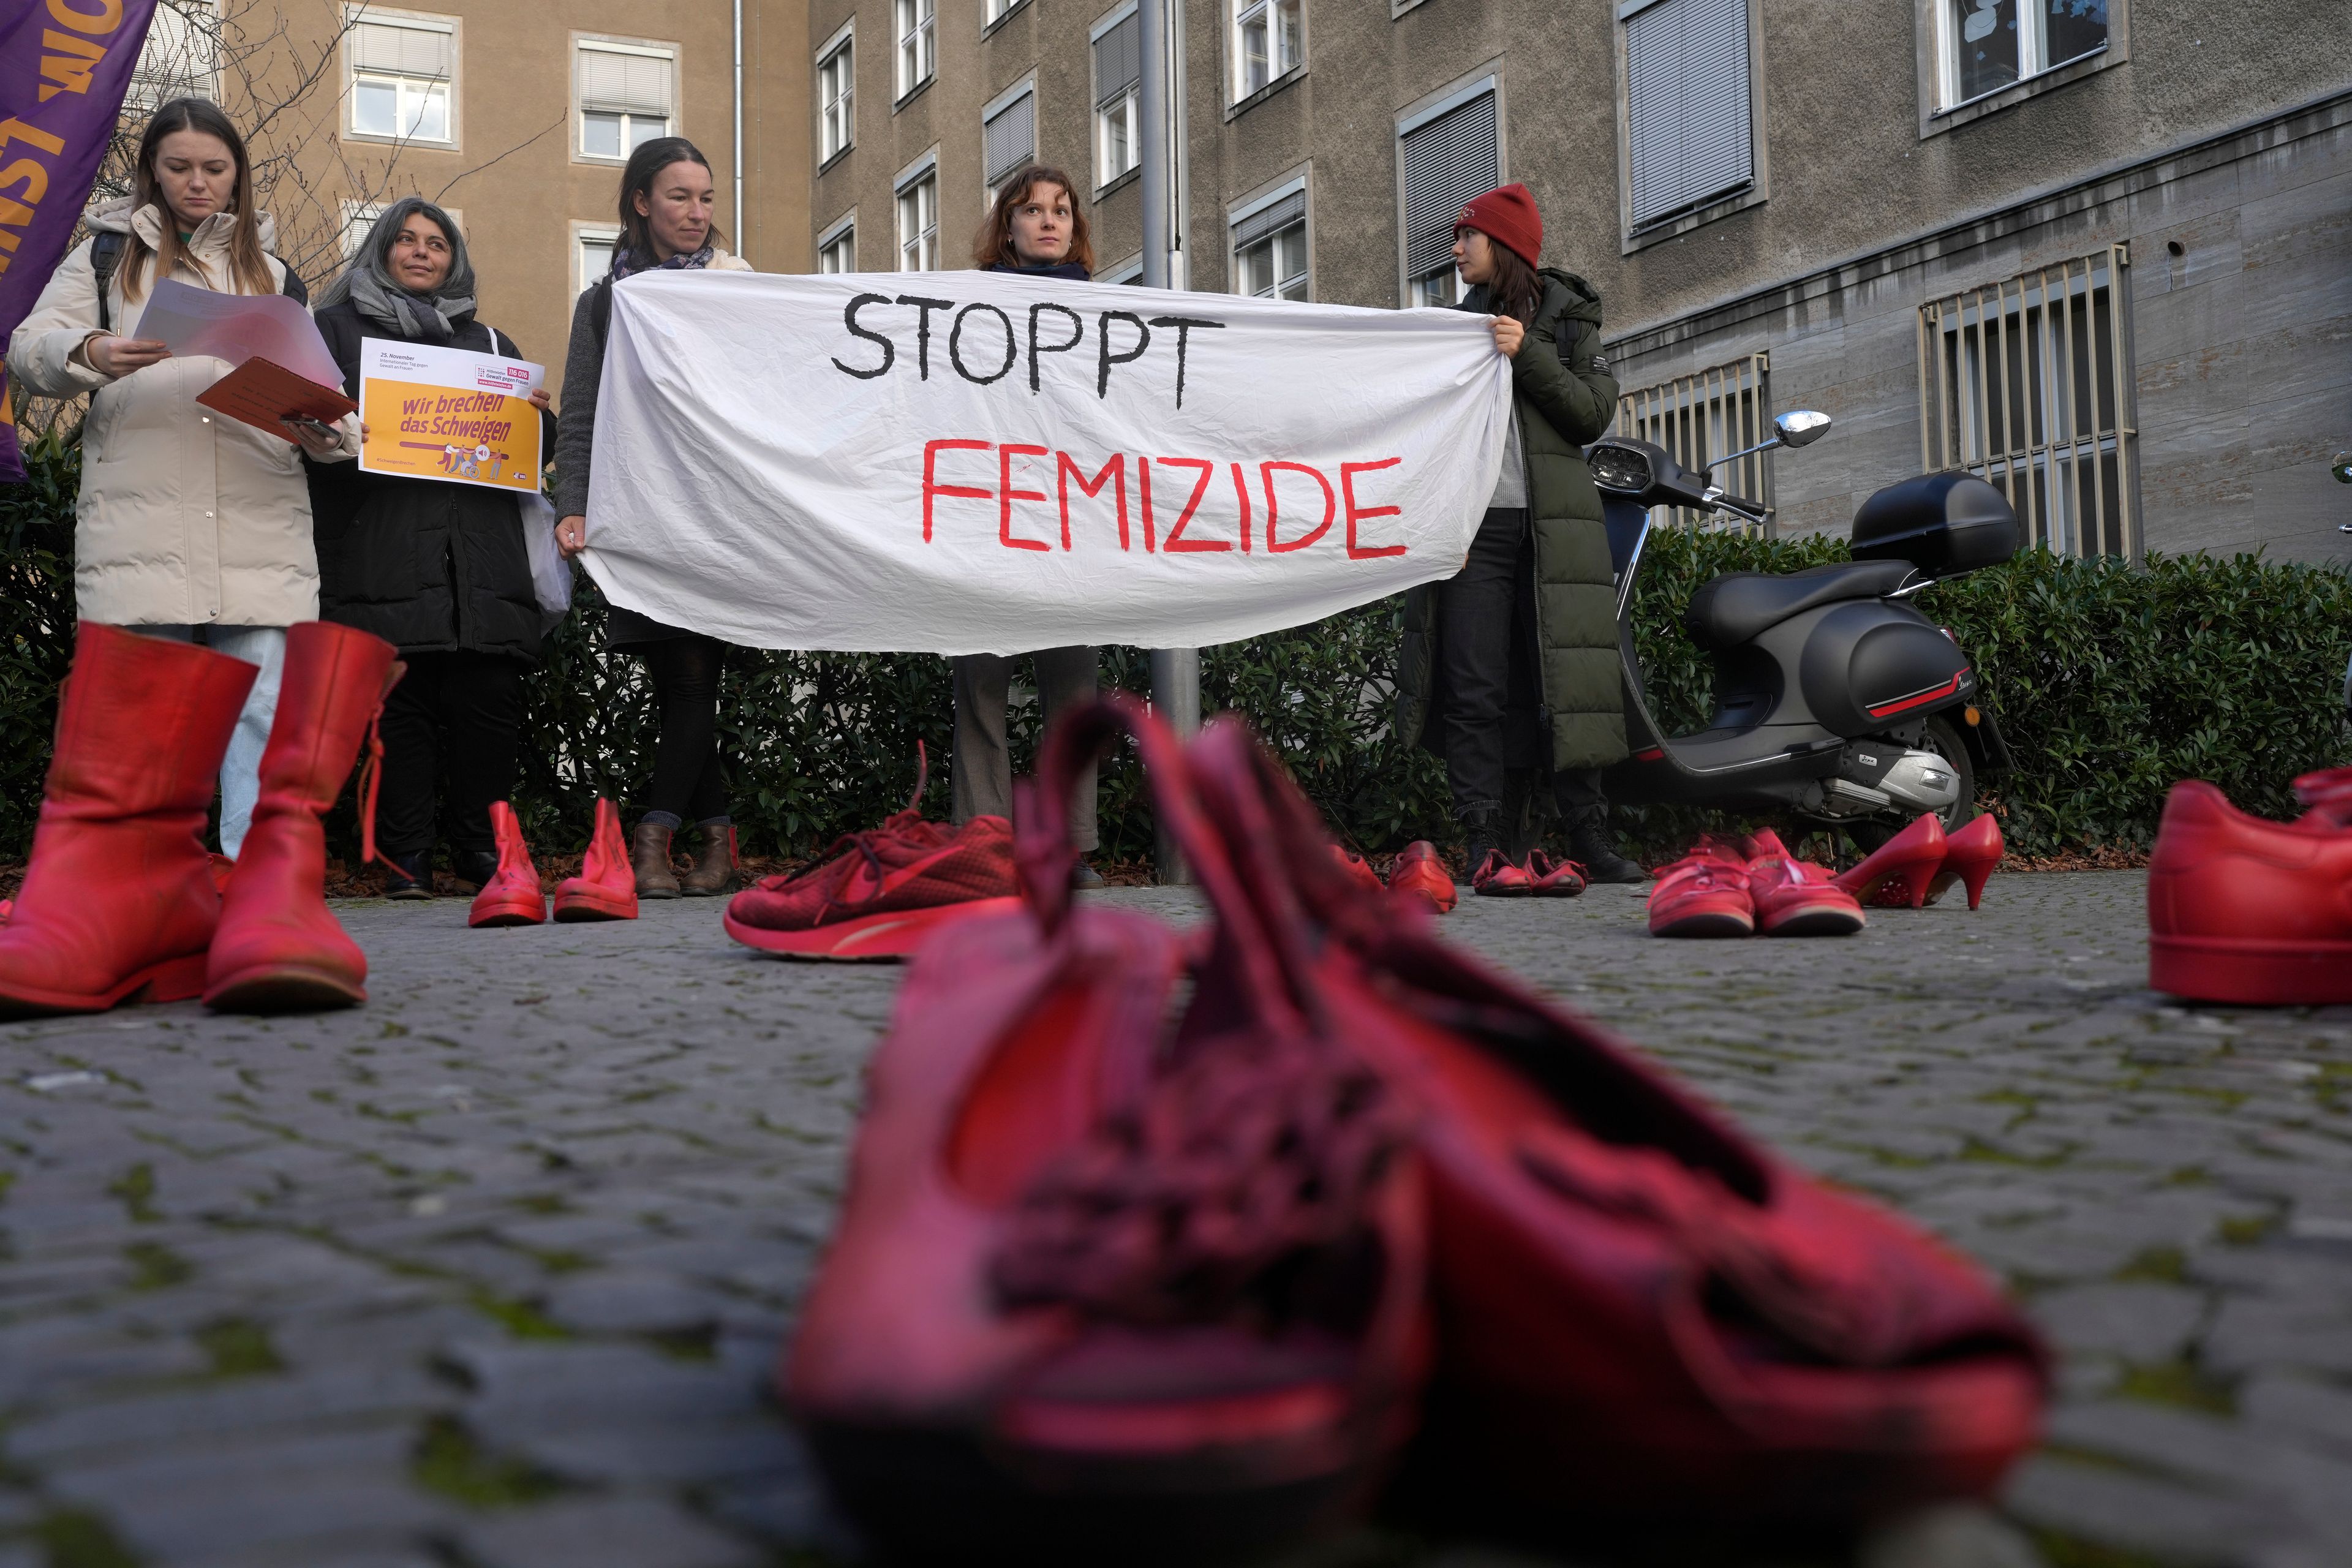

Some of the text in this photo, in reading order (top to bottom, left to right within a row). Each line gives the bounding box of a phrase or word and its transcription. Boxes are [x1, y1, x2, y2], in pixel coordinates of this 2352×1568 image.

[831, 292, 1227, 411] STOPPT
[400, 415, 511, 445] das Schweigen
[403, 391, 505, 415] Wir brechen
[922, 439, 1410, 560] FEMIZIDE
